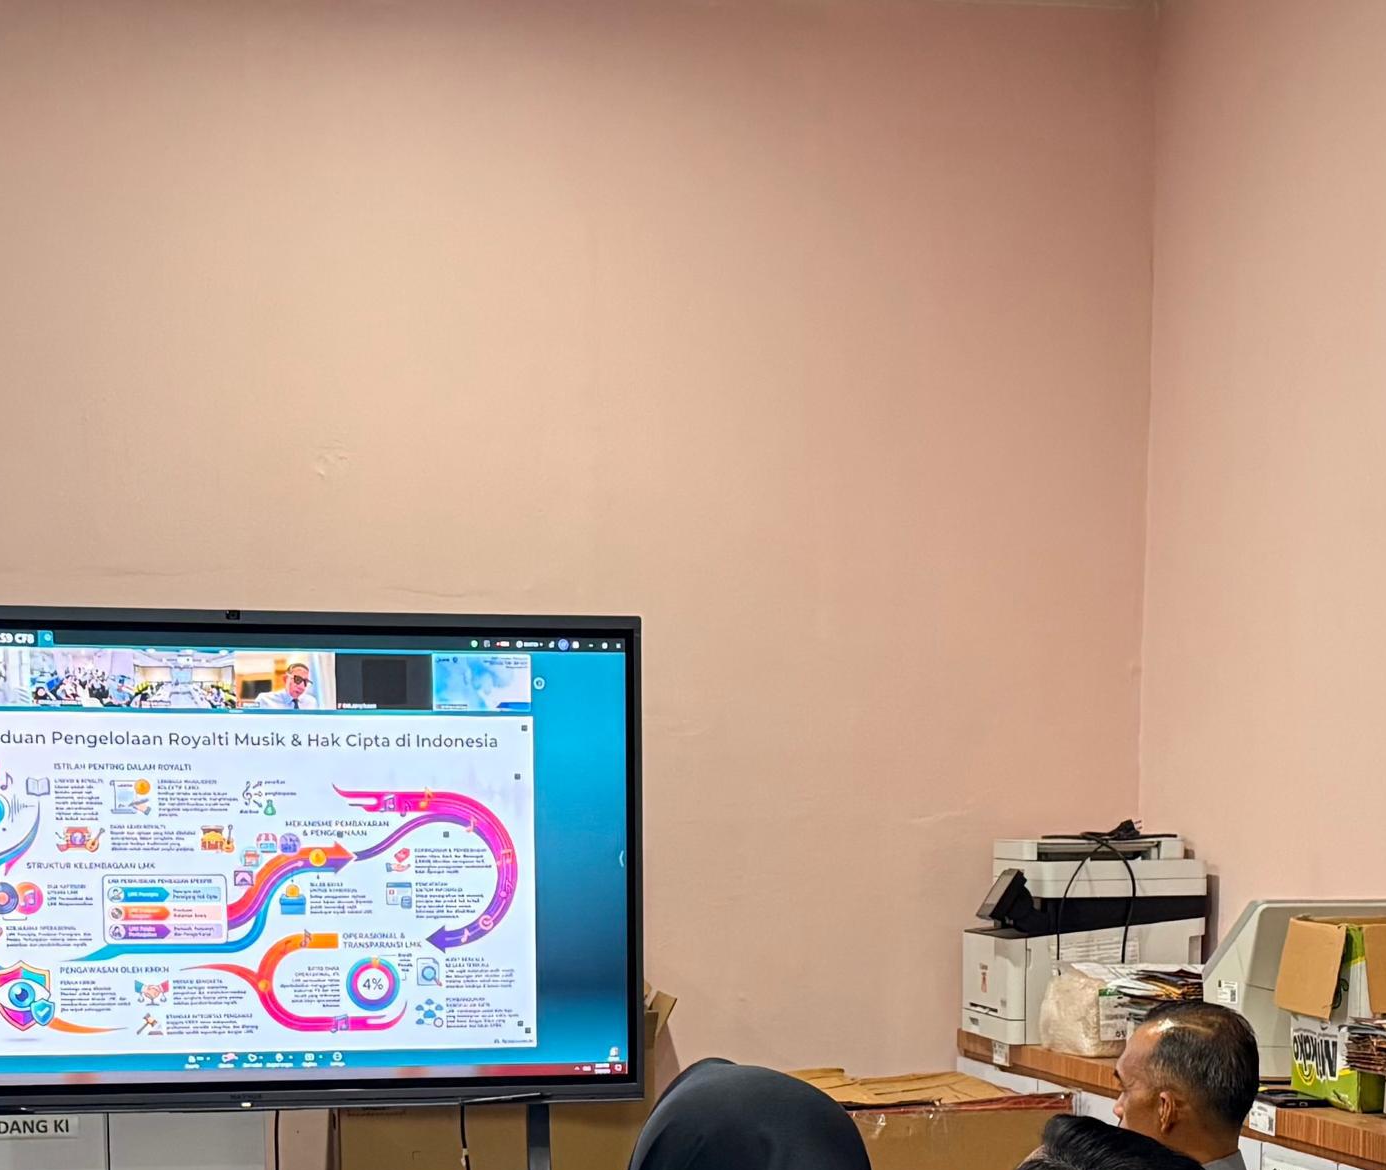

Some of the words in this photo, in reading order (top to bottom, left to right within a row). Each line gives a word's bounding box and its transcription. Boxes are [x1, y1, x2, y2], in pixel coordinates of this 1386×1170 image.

[51, 731, 164, 748] Pengelolaan
[169, 731, 230, 748] Royalti
[234, 732, 286, 747] Musik
[291, 733, 303, 747] &
[307, 733, 341, 747] Hak
[345, 733, 391, 750] Cipta
[395, 733, 411, 747] di
[416, 733, 498, 748] Indonesia
[88, 763, 125, 771] PENTING
[158, 764, 192, 772] ROYALTI
[26, 862, 71, 870] STRUKTUR
[342, 932, 398, 940] OPERASIONAL
[342, 941, 404, 949] TRANSPARANSI
[59, 966, 119, 975] PENGAWASAN
[120, 966, 143, 974] OLEH
[362, 977, 384, 991] 4%
[53, 1119, 71, 1134] KI
